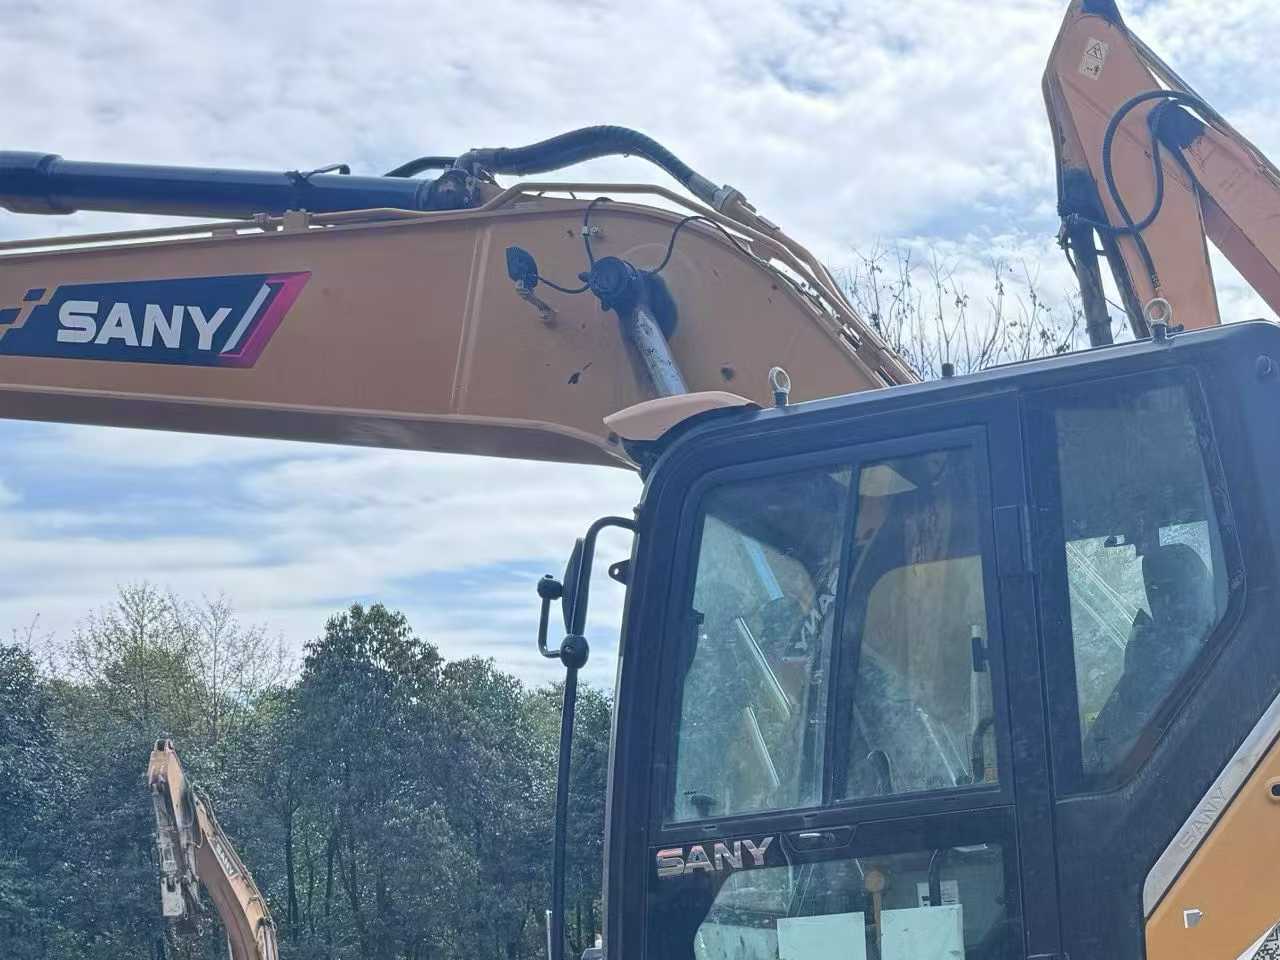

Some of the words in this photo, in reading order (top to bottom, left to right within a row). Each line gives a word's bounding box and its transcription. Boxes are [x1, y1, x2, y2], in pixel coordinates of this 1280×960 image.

[57, 299, 233, 351] SANY
[1179, 786, 1227, 850] SANY
[656, 836, 774, 878] SANY
